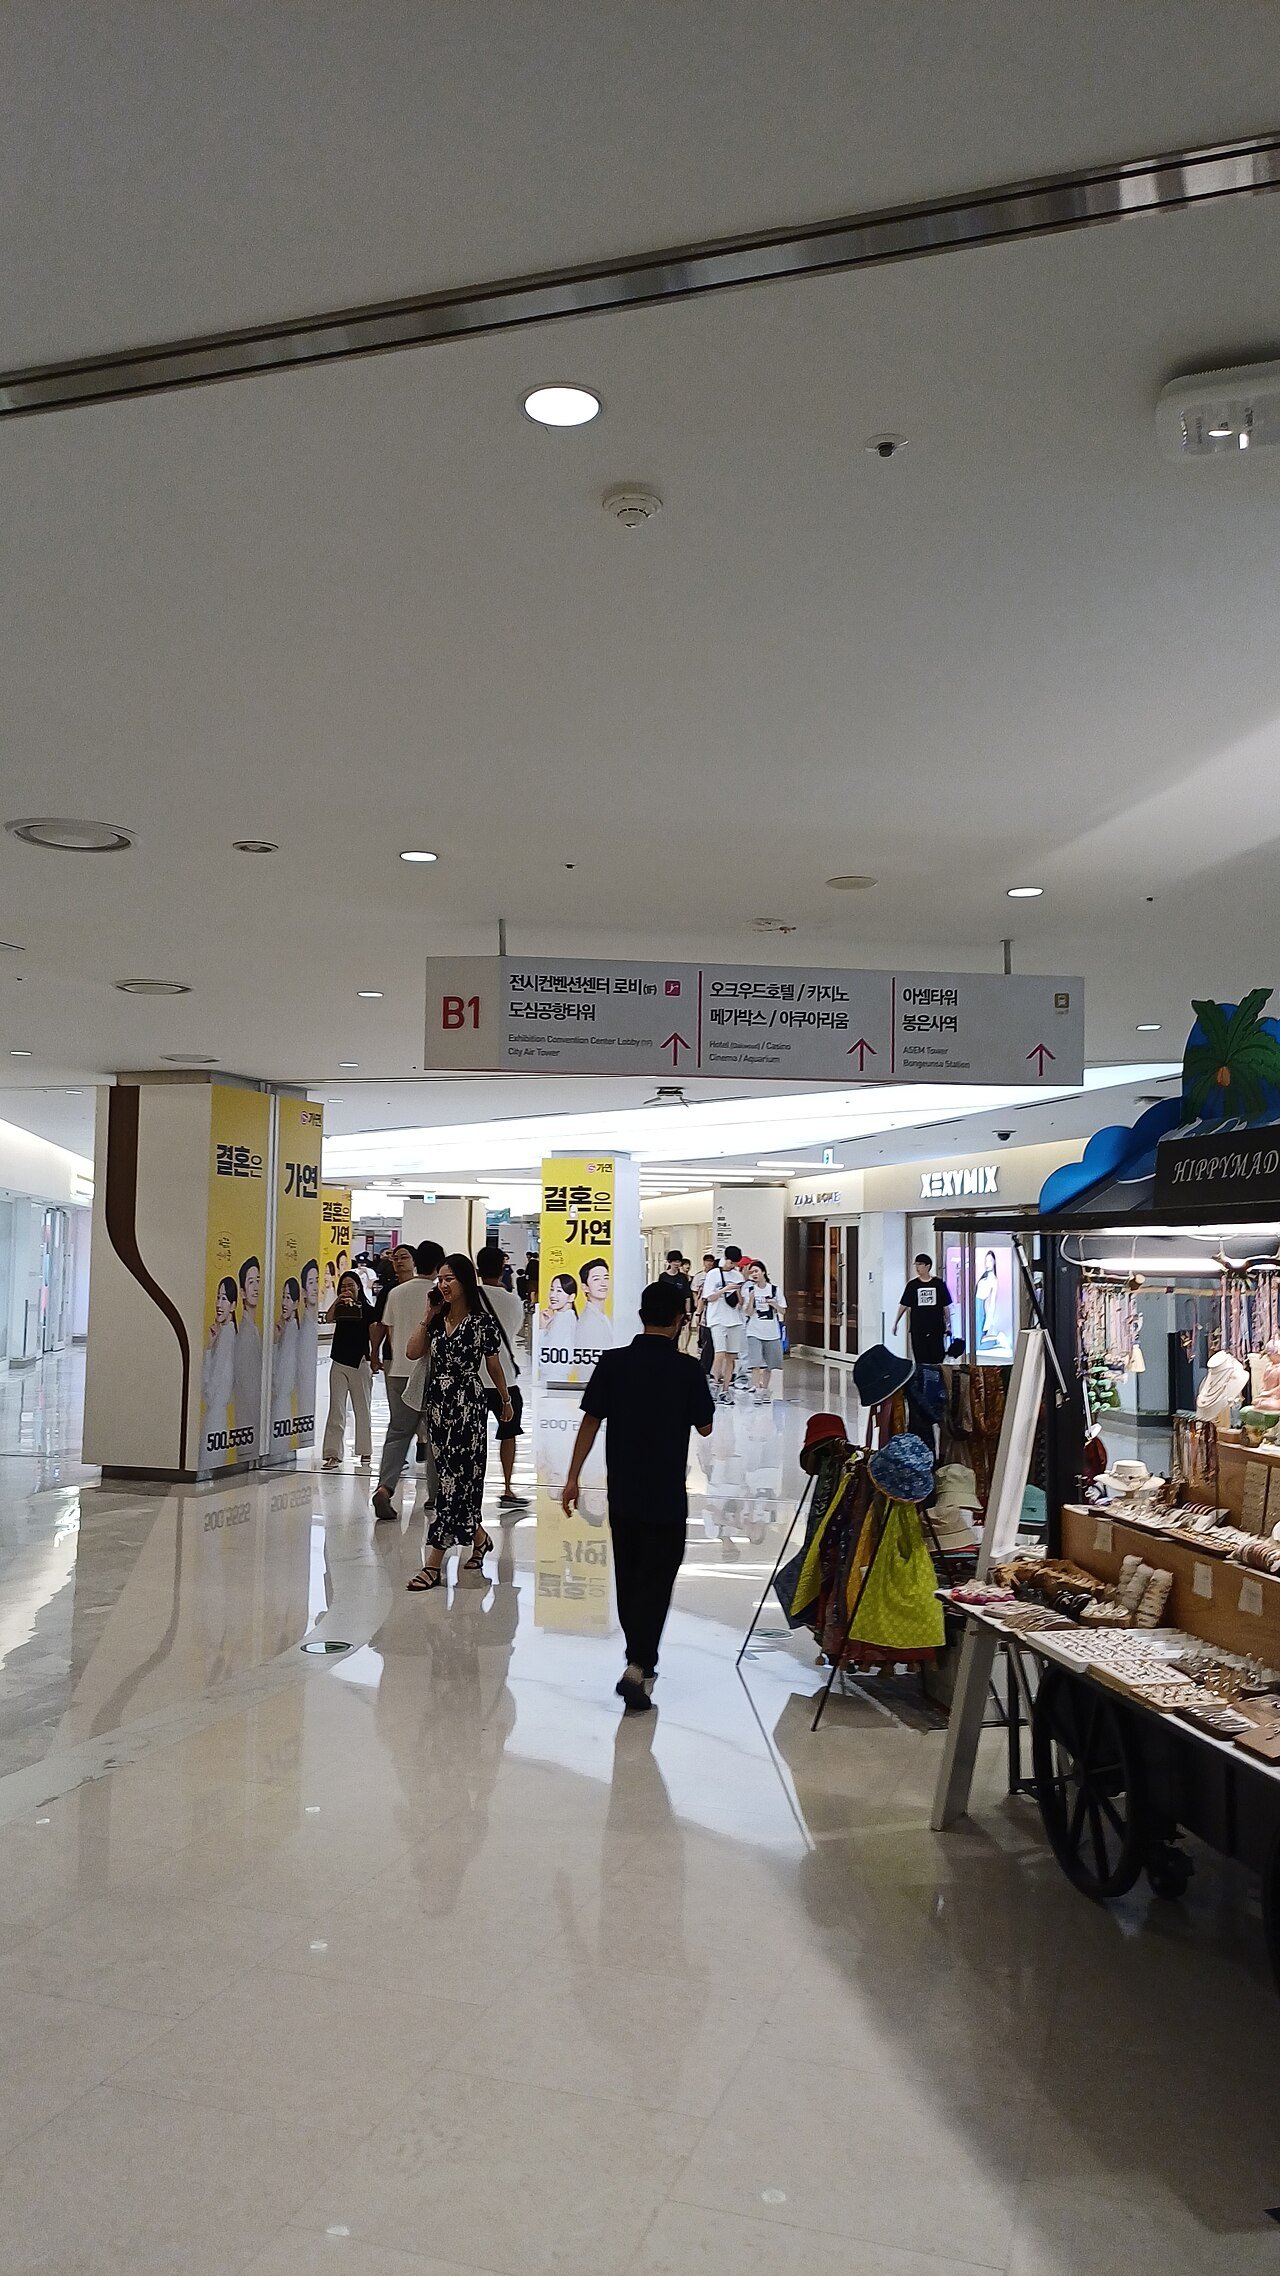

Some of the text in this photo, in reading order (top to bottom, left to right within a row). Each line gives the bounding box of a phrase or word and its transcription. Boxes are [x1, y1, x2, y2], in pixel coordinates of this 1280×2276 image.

[509, 974, 610, 995] 전시컨벤션센터
[710, 982, 795, 1001] 오크우드호텔
[807, 985, 850, 1002] 카지노
[902, 988, 958, 1006] 아셈타워
[442, 996, 480, 1029] B1
[508, 1002, 596, 1022] 도심공항타워
[710, 1009, 767, 1026] 메가박스
[780, 1011, 850, 1029] 아쿠아리움
[902, 1014, 958, 1032] 봉은사역
[508, 1034, 546, 1043] Exhibition
[547, 1035, 589, 1045] Convention
[590, 1036, 617, 1046] Center
[617, 1037, 641, 1048] Lobby
[709, 1040, 730, 1049] Hotel
[926, 1046, 949, 1055] Tower
[508, 1047, 561, 1057] City Air Tower
[709, 1053, 738, 1062] Cinema
[743, 1055, 780, 1064] Aquarium
[216, 1143, 263, 1179] 결혼은
[1172, 1149, 1280, 1185] HIPPYMAD
[284, 1162, 319, 1199] 가연
[919, 1164, 1000, 1200] XEXYMIX
[544, 1185, 612, 1212] 결혼은
[322, 1201, 350, 1222] 결혼은
[330, 1225, 350, 1246] 가연
[564, 1219, 612, 1246] 가연
[539, 1347, 603, 1365] 500.555
